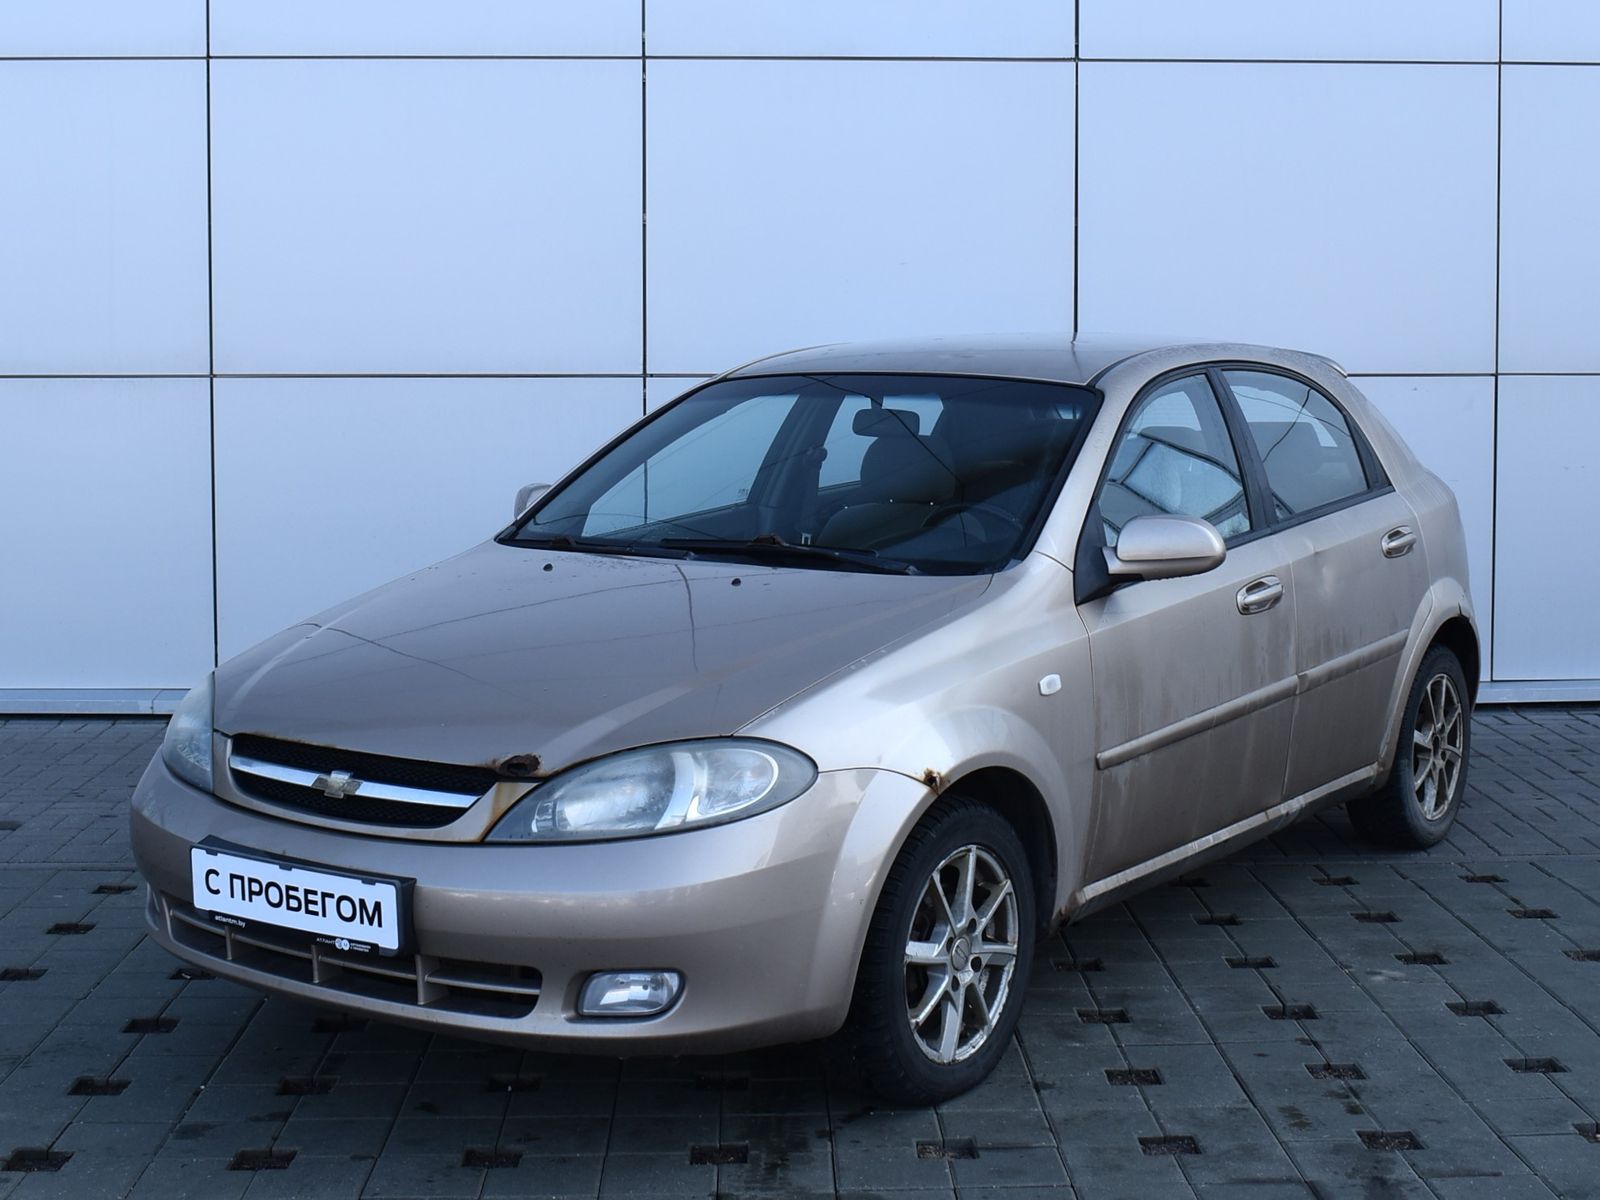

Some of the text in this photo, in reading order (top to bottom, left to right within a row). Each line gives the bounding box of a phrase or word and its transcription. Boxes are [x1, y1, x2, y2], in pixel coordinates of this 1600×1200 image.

[204, 868, 383, 928] С ПРОБЕГОМ
[214, 914, 246, 928] atlantm.by
